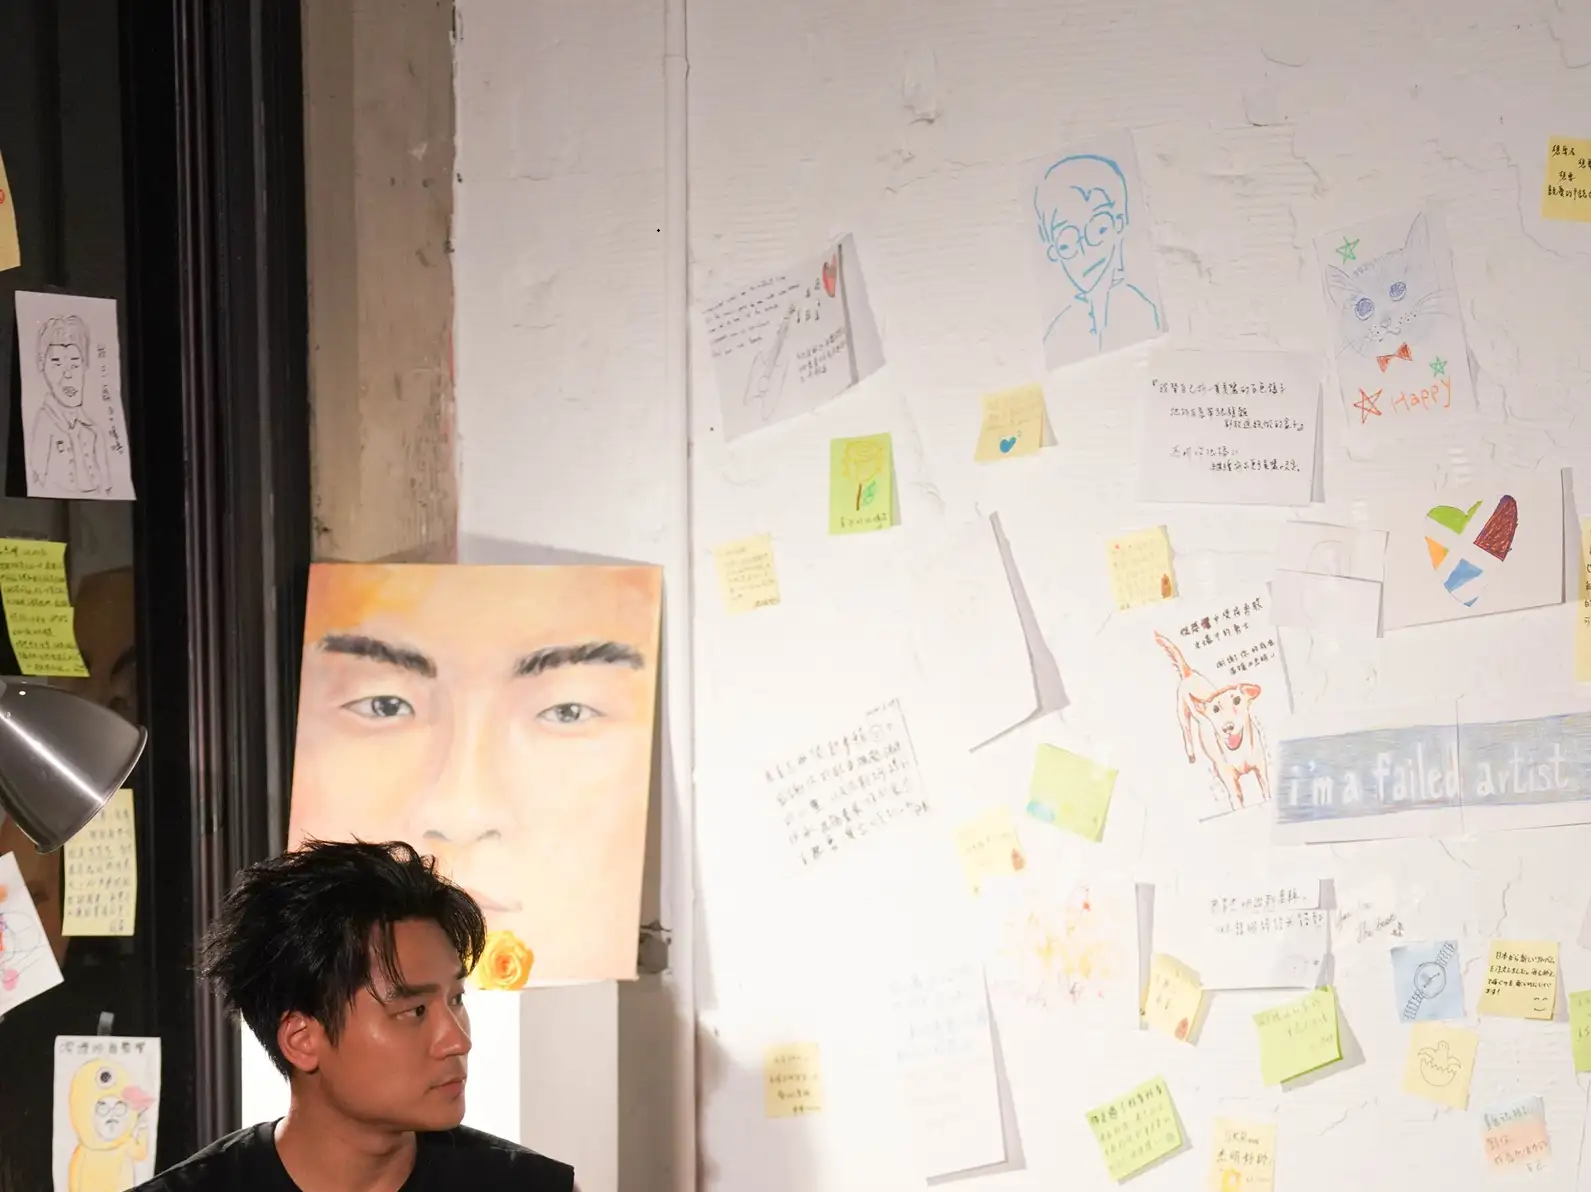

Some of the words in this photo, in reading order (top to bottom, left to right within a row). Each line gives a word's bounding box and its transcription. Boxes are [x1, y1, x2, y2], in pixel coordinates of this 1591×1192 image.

[1390, 375, 1452, 413] Happy
[1343, 770, 1361, 805] a
[1371, 741, 1463, 803] failed
[1476, 742, 1569, 797] artist
